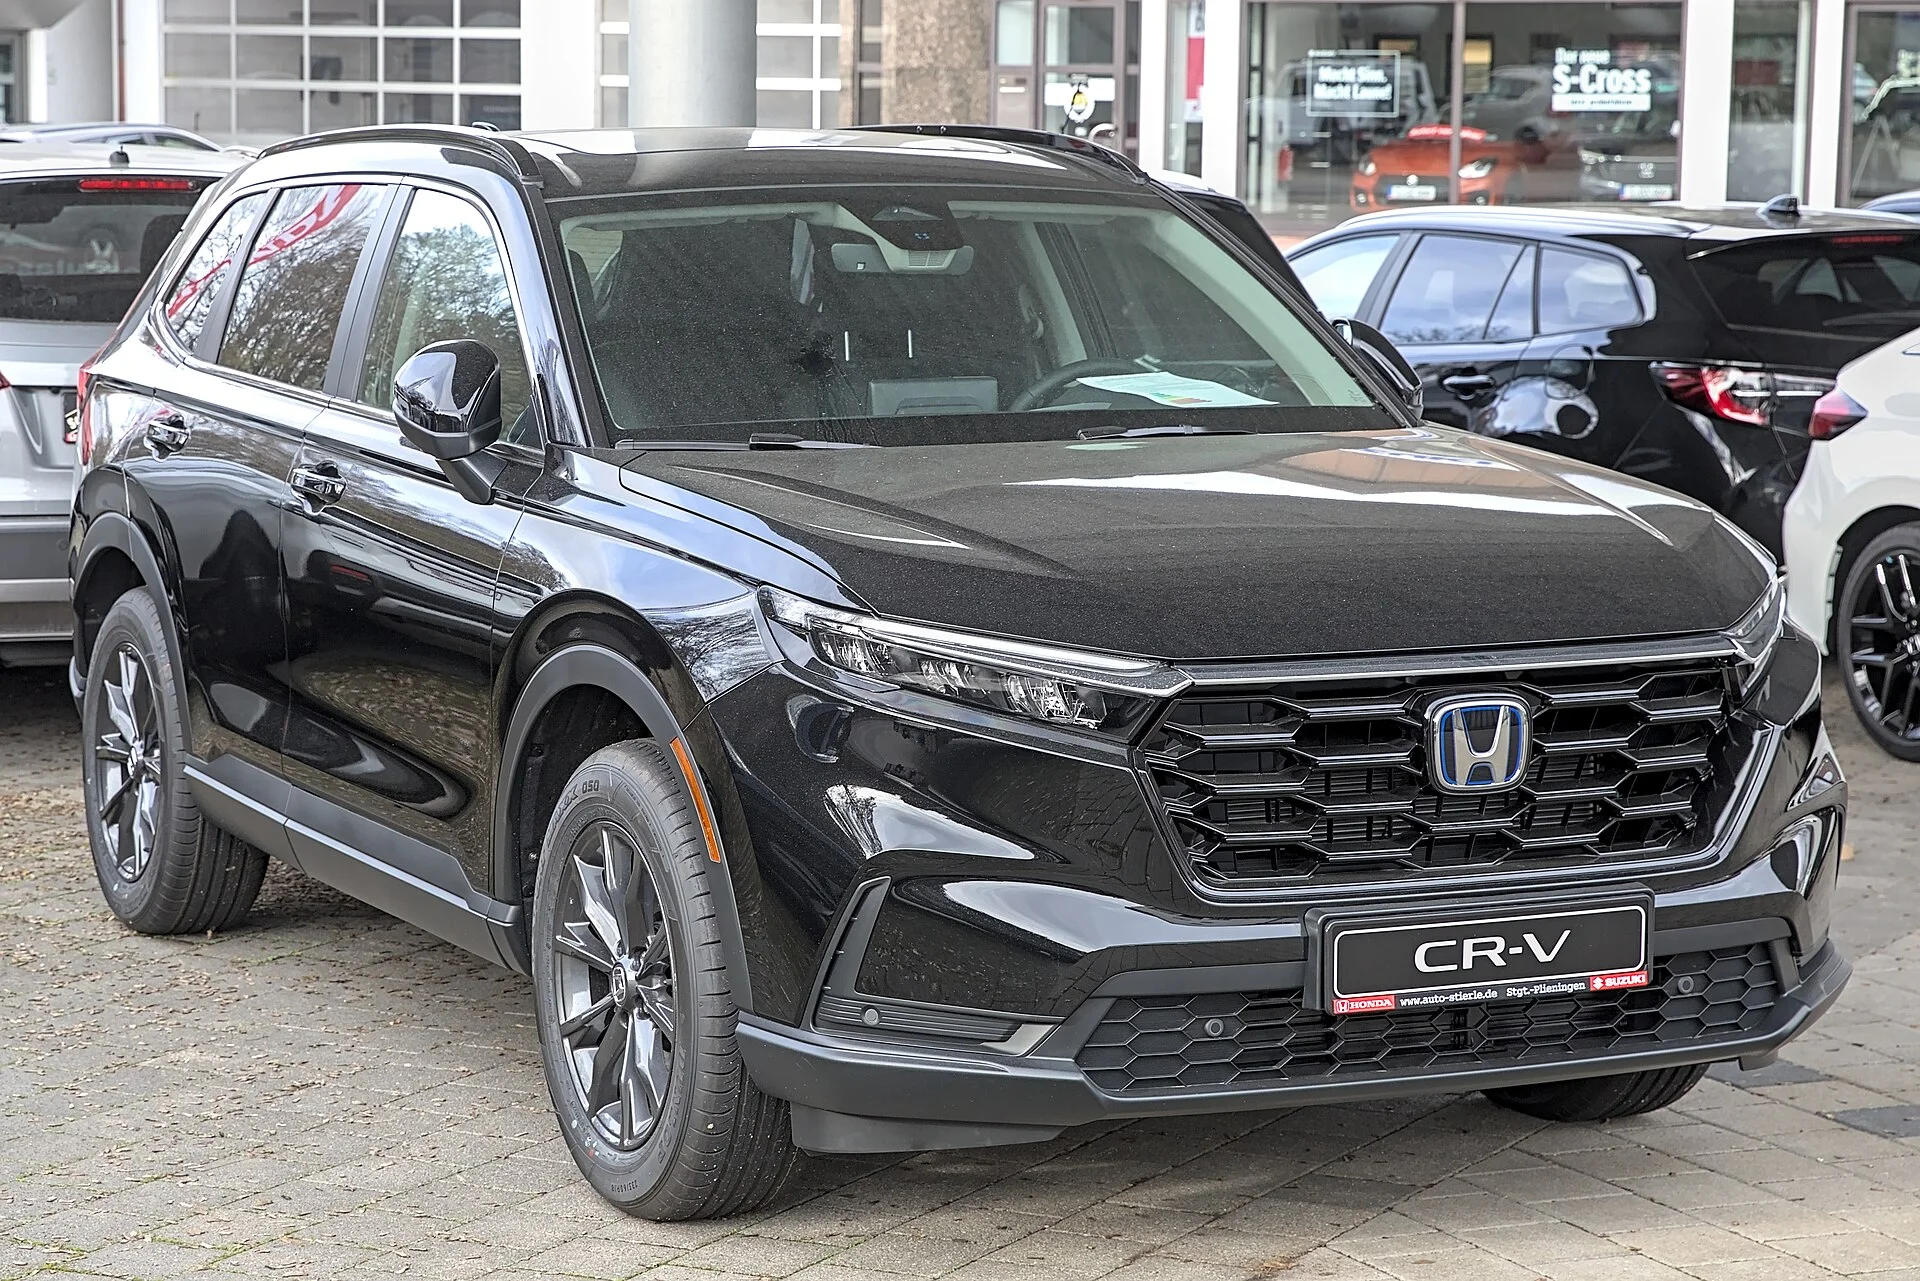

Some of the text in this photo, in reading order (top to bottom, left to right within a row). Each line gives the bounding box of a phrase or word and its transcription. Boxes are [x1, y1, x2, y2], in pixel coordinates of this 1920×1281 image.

[1552, 63, 1652, 94] S-Cross
[1414, 929, 1571, 973] CR-V
[1350, 974, 1646, 1010] HONDA www.auto-stierle.de Stgt.-Plieningen SUZUKI
